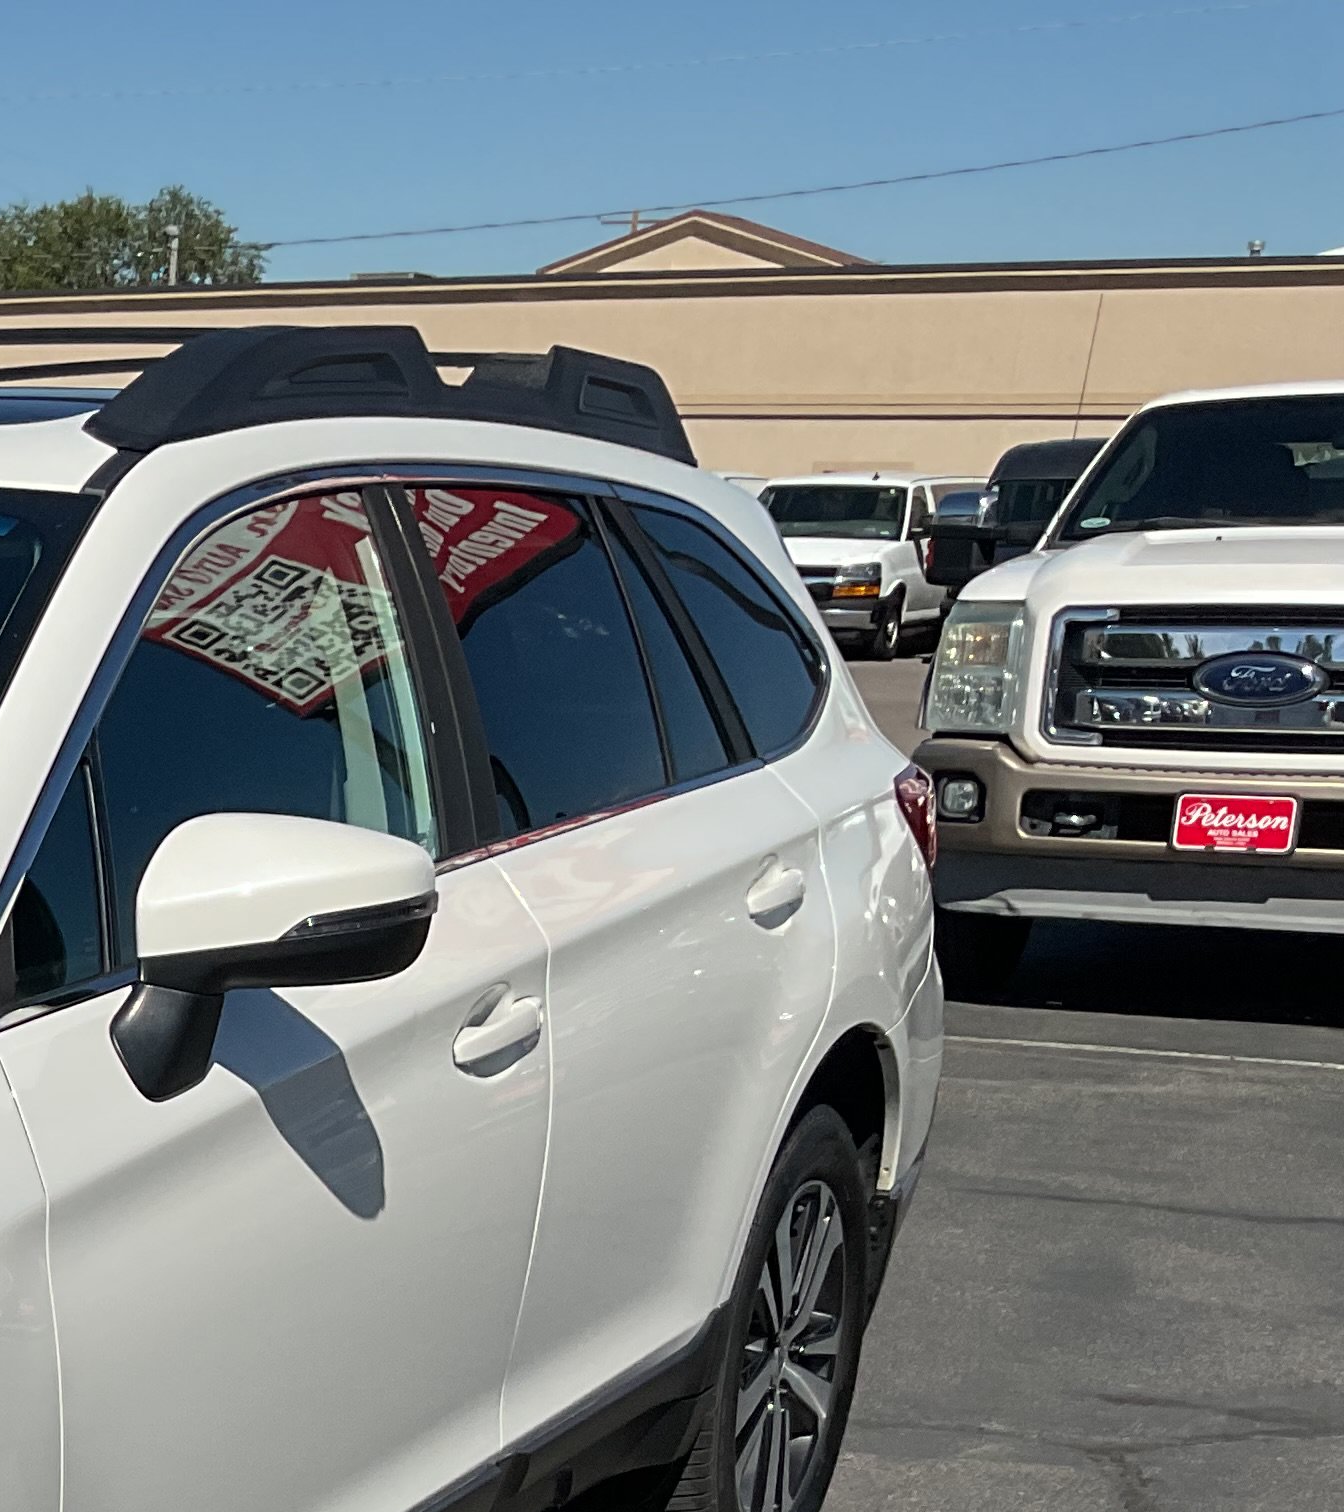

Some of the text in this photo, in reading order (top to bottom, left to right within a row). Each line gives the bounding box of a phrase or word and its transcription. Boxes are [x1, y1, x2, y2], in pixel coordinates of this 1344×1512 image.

[1222, 665, 1293, 692] Ford
[1180, 802, 1289, 830] Peterson
[1206, 829, 1259, 838] AUTO SALES
